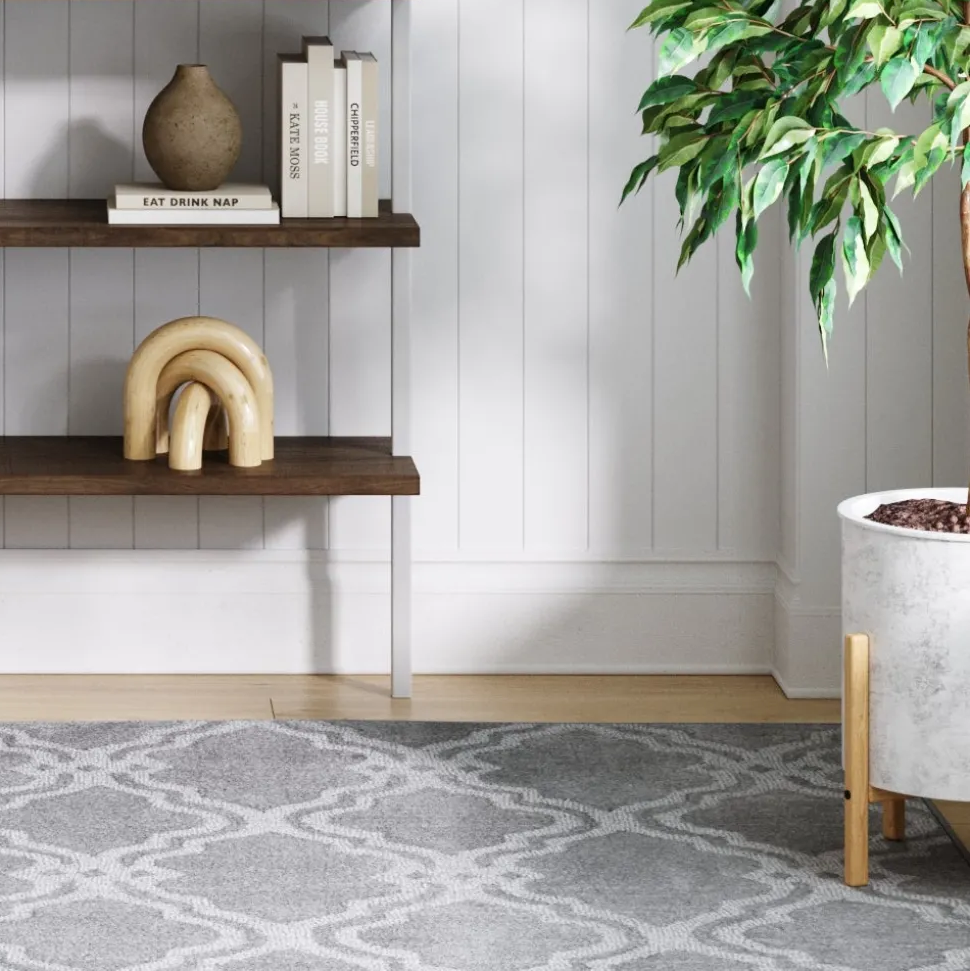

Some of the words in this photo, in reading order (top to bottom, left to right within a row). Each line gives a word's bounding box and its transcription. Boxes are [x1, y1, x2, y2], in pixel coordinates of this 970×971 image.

[289, 113, 300, 144] KATE
[314, 100, 328, 136] HOUSE
[350, 102, 360, 167] CHIPPERFIELD
[289, 147, 300, 179] MOSS
[314, 138, 328, 164] BOOK
[143, 198, 165, 207] EAT
[170, 198, 209, 207] DRINK
[213, 198, 239, 207] NAP
